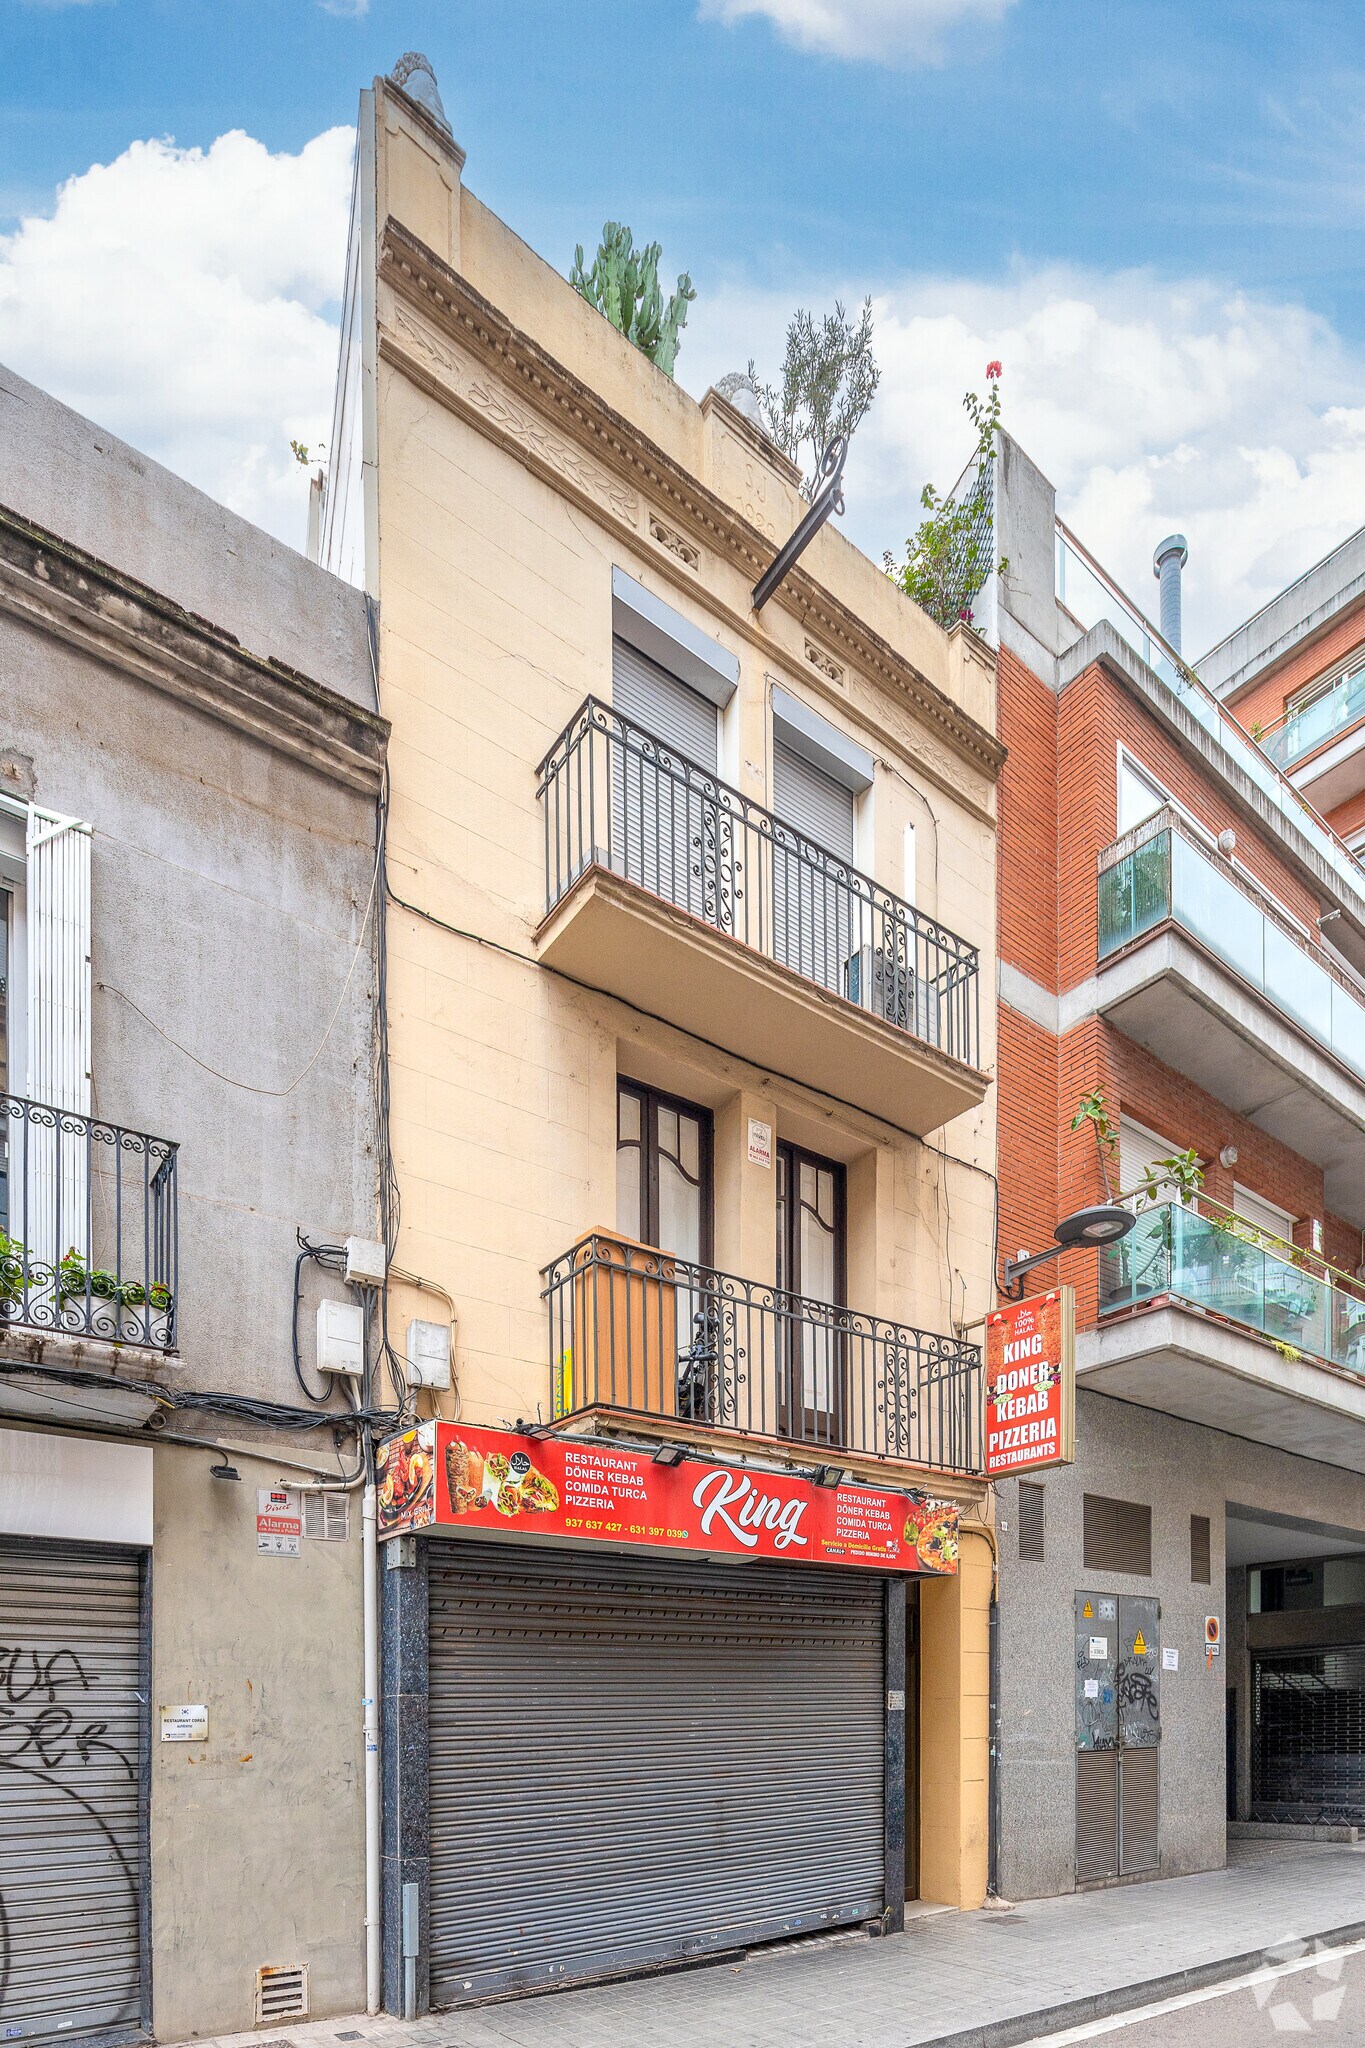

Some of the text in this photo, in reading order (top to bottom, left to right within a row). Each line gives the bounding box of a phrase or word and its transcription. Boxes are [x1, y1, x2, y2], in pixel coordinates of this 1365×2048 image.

[750, 1145, 770, 1158] ALARMA
[1014, 1315, 1035, 1329] 100%
[1014, 1325, 1034, 1336] HALAL
[1003, 1333, 1042, 1365] KING
[996, 1361, 1049, 1395] DONER
[996, 1390, 1049, 1423] KEBAB
[989, 1417, 1057, 1453] PIZZERIA
[565, 1452, 637, 1472] RESTAURANT
[989, 1442, 1056, 1469] RESTAURANTS
[565, 1465, 644, 1486] DÖNER KEBAB
[565, 1480, 648, 1500] COMIDA TURCA
[264, 1503, 292, 1513] Direct
[565, 1495, 615, 1510] PIZZERIA
[836, 1492, 887, 1508] RESTAURANT
[413, 1503, 433, 1515] GRILL
[691, 1470, 809, 1550] King
[836, 1504, 890, 1520] DÖNER KEBAB
[259, 1518, 299, 1530] Alarma
[565, 1518, 583, 1528] 937
[585, 1520, 603, 1530] 637
[605, 1522, 622, 1532] 427
[630, 1525, 646, 1535] 631
[649, 1527, 664, 1537] 397
[666, 1528, 682, 1538] 039
[836, 1516, 893, 1532] COMIDA TURCA
[836, 1528, 870, 1540] PIZZERIA
[821, 1539, 843, 1548] Servicio
[847, 1542, 871, 1551] Domicilio
